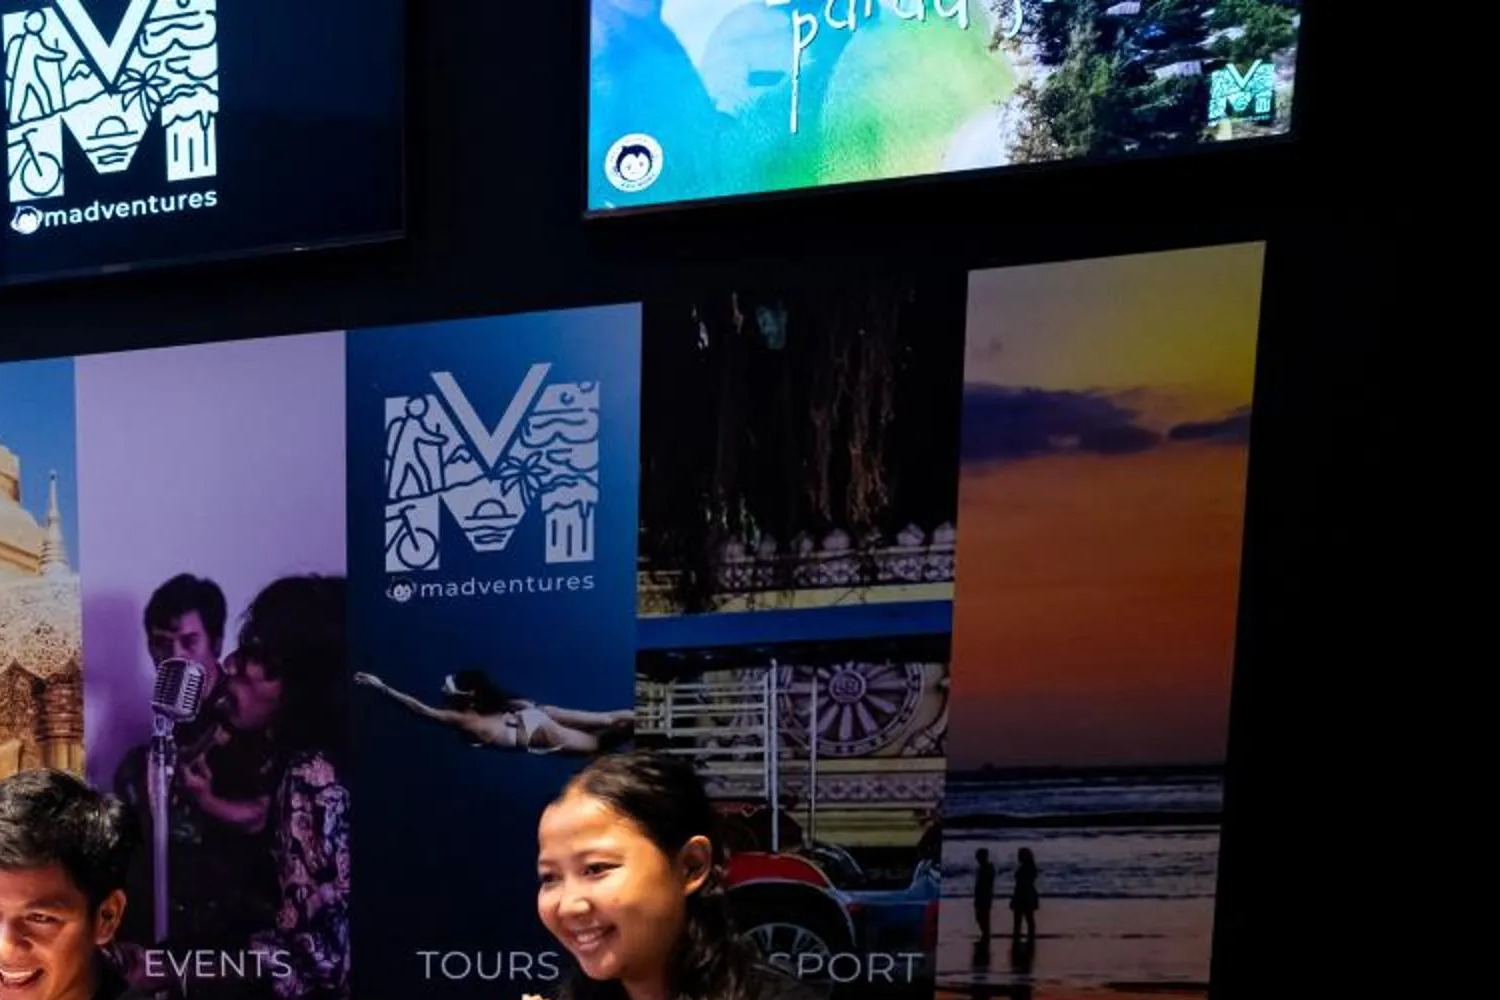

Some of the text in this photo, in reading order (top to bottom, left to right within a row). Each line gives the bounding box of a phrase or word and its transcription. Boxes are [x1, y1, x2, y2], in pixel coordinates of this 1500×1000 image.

[44, 190, 218, 228] madventures
[421, 574, 596, 598] madventures
[145, 949, 292, 979] EVENTS
[416, 951, 560, 981] TOURS
